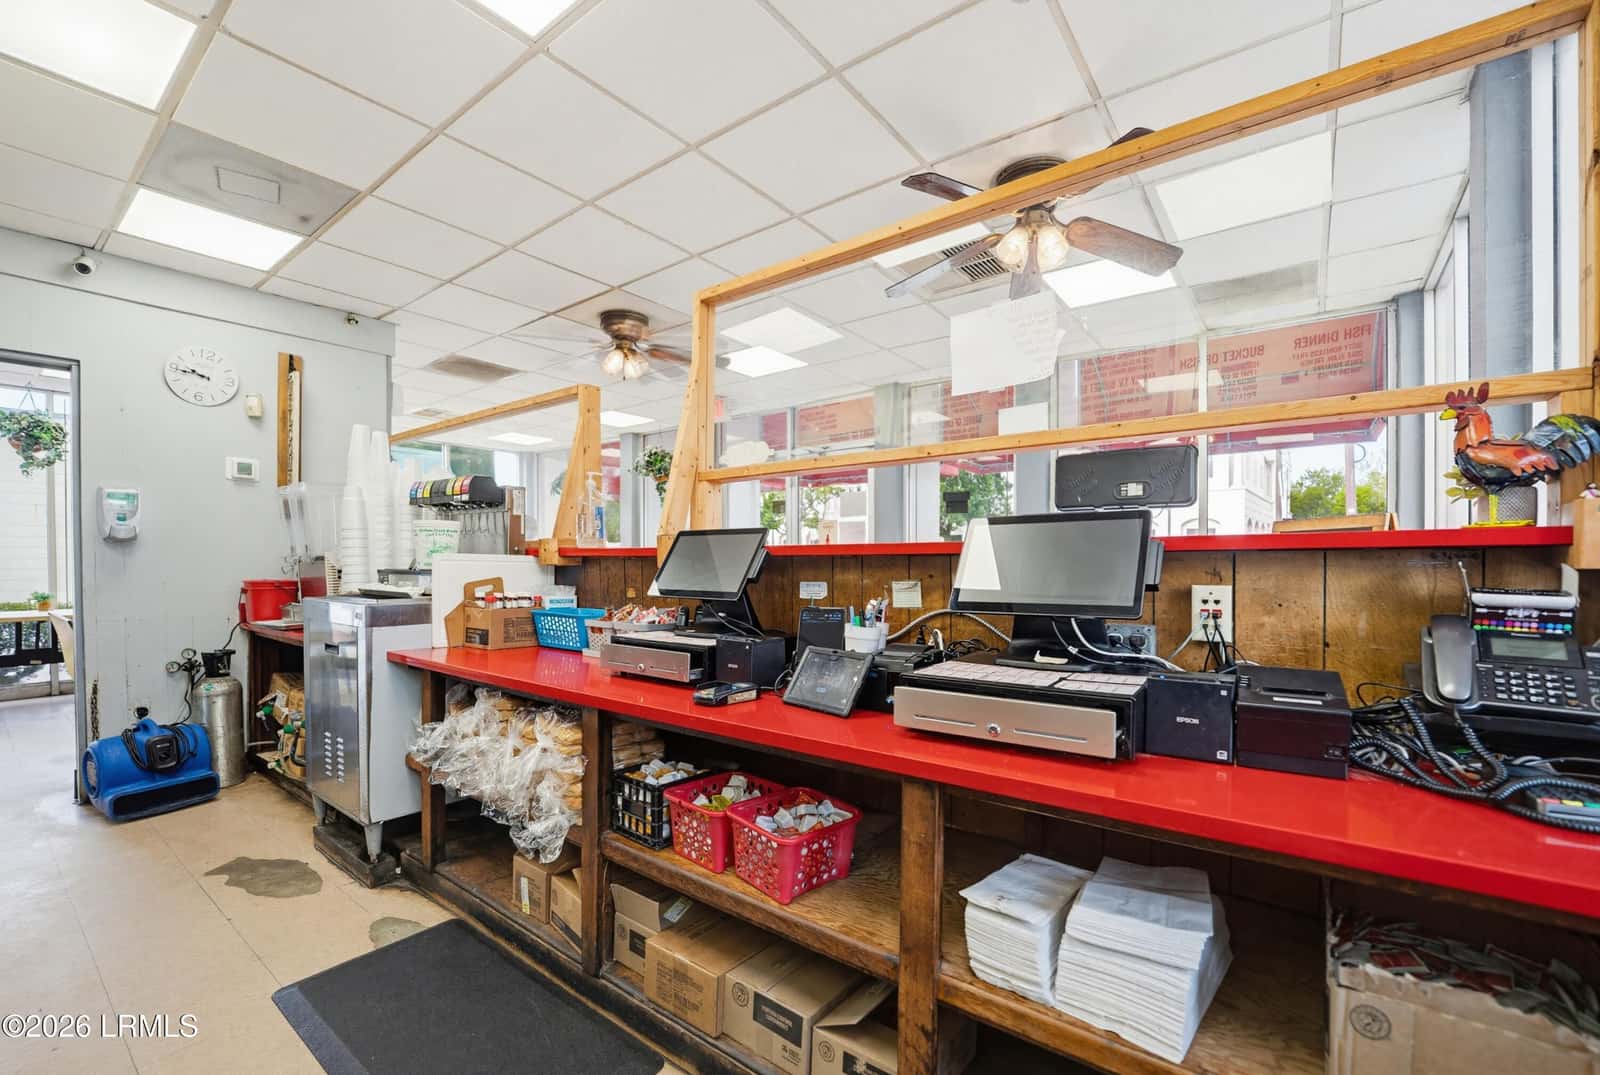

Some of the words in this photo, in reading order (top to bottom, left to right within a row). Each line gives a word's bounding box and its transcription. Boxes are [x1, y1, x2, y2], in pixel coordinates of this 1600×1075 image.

[200, 348, 216, 361] 12
[194, 391, 204, 402] 6
[1176, 716, 1200, 725] EPSON
